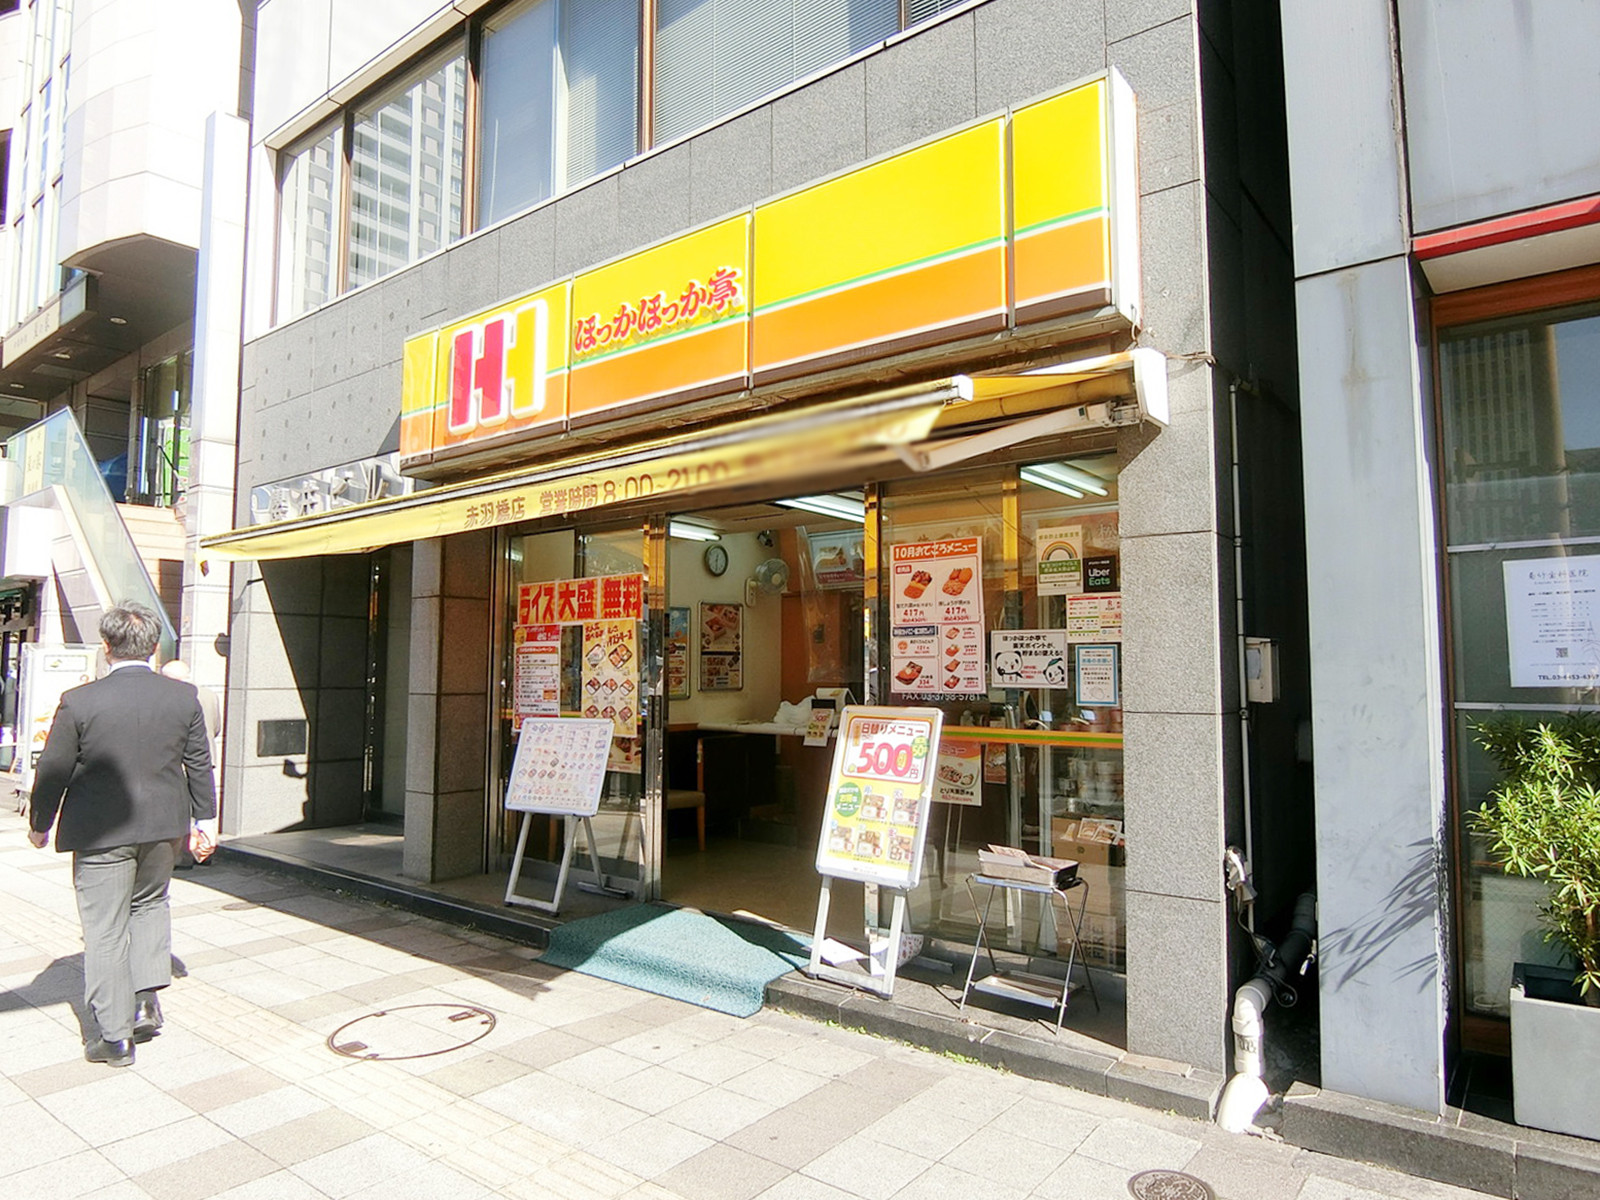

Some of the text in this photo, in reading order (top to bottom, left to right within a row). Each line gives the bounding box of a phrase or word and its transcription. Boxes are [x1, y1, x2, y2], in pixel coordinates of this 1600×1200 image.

[574, 267, 739, 350] ほっかほっか亭
[463, 496, 526, 528] 赤羽橋店
[539, 484, 598, 516] 営業時間
[894, 543, 977, 559] 10月おてごろメニュー
[1088, 568, 1110, 577] Uber
[1088, 577, 1111, 586] Eats
[519, 576, 642, 624] ライス大盛無料
[861, 723, 925, 737] 日替りメニュー
